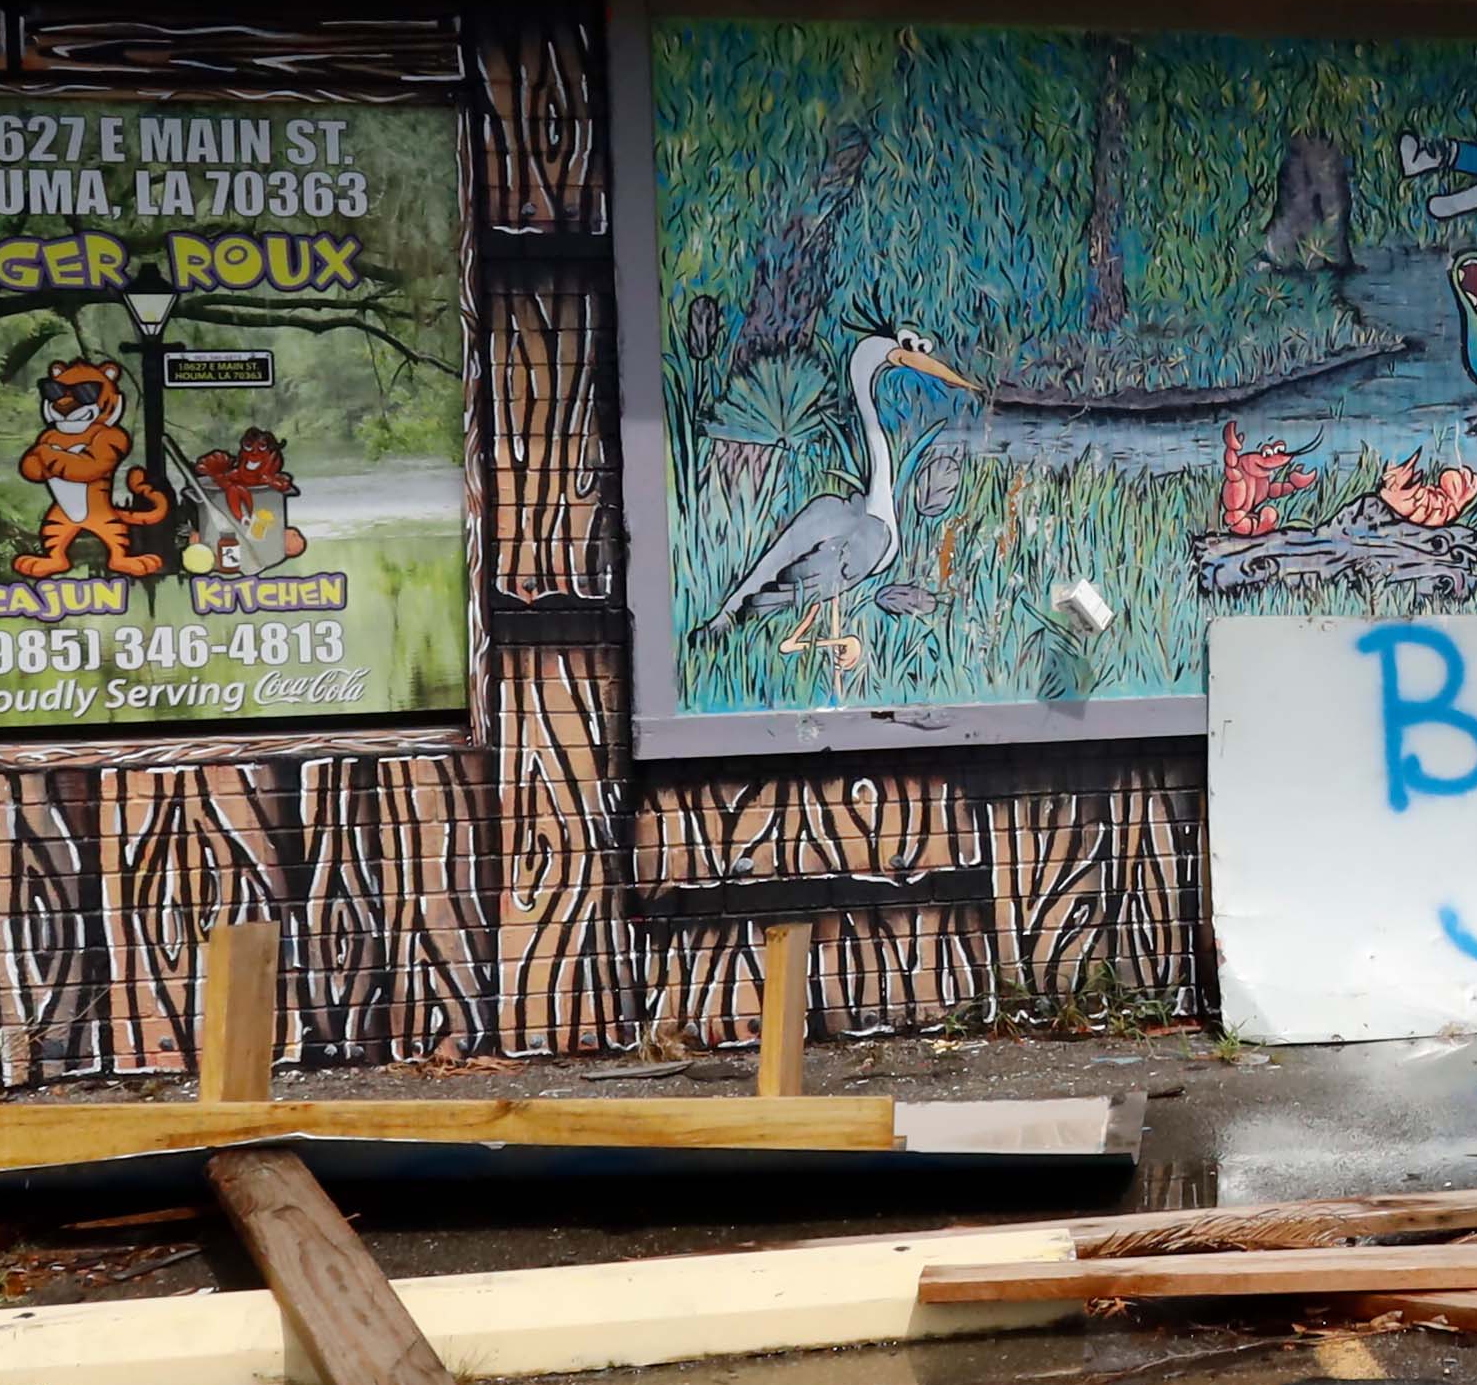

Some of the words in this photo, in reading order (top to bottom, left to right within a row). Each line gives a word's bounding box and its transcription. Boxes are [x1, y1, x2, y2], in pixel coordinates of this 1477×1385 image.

[100, 116, 125, 163] E
[139, 117, 271, 165] MAIN
[285, 119, 354, 166] ST.
[135, 169, 195, 216] LA
[205, 170, 368, 217] 70363
[168, 230, 362, 292] ROUX
[192, 572, 347, 615] KiTCHEN
[114, 620, 344, 672] 346-4813
[104, 678, 246, 713] Serving
[254, 668, 371, 706] Coca-Cola
